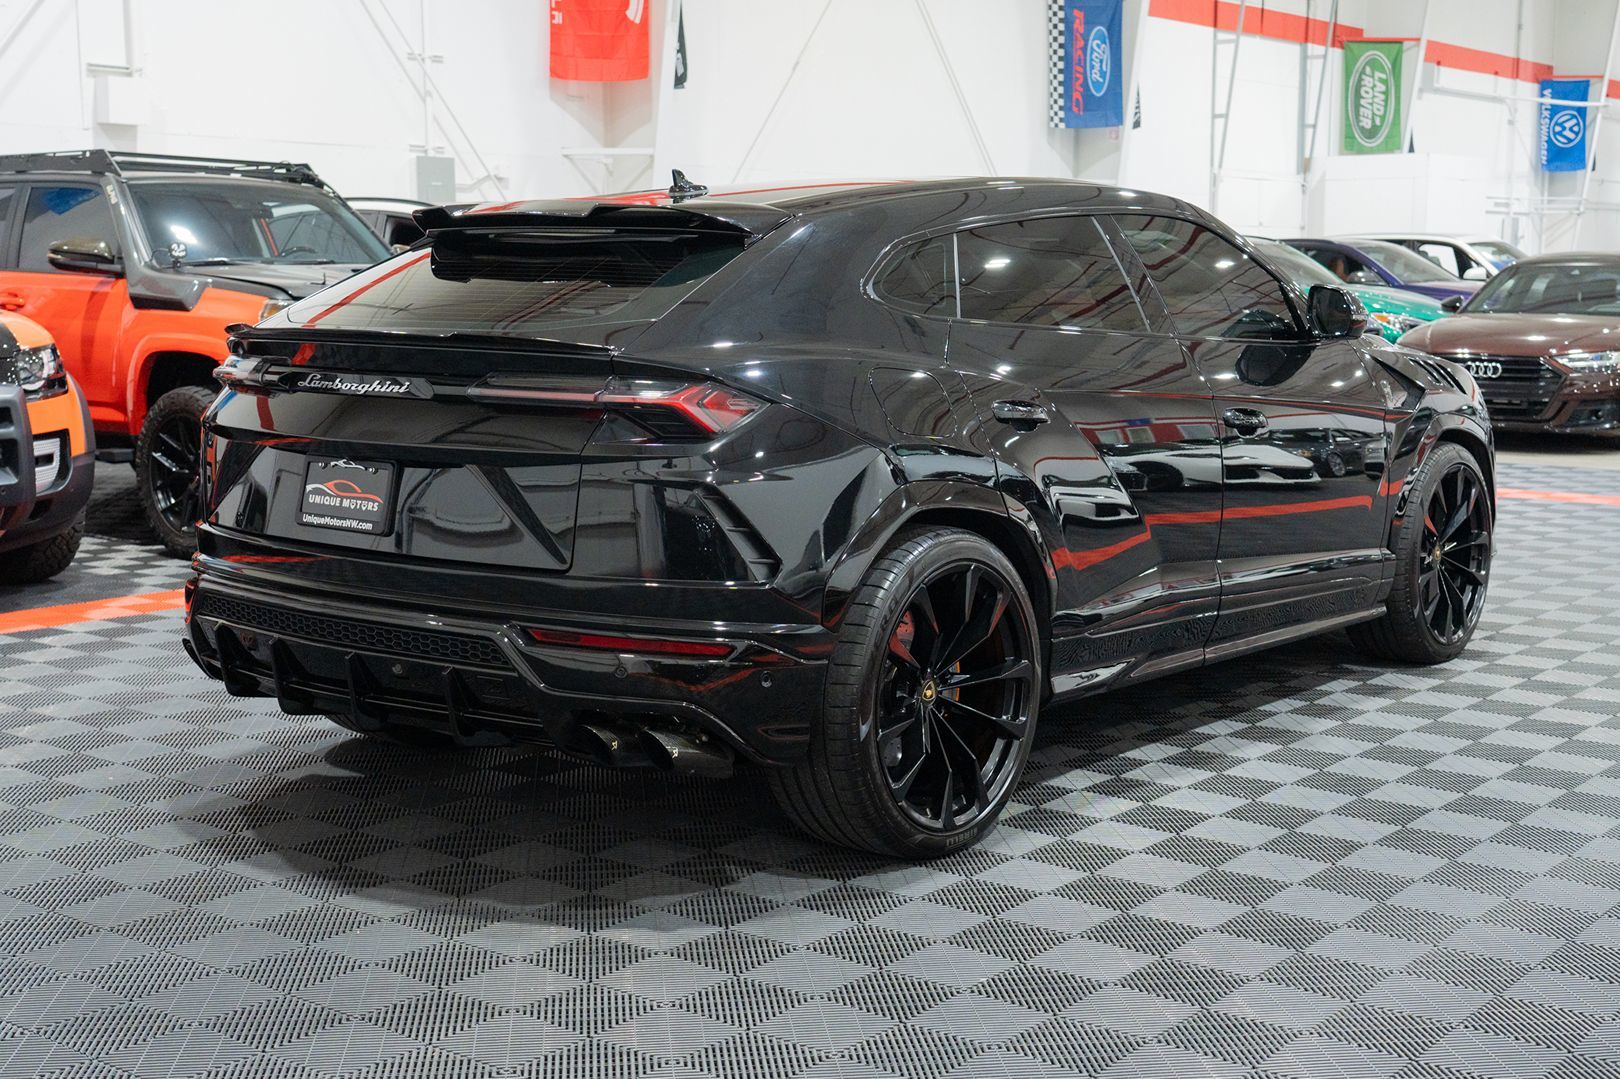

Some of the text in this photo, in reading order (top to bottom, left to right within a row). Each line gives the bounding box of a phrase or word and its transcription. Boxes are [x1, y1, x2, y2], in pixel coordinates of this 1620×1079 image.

[1072, 8, 1085, 115] RACING
[1091, 39, 1107, 83] Ford
[1359, 73, 1374, 129] ROVER
[1373, 70, 1387, 117] LAND
[1541, 88, 1553, 165] VLKSWAGEN
[297, 373, 411, 394] Lamborghini
[302, 513, 373, 530] UniqueMotorsNW.com
[308, 494, 379, 511] UNIQUE MOTORS
